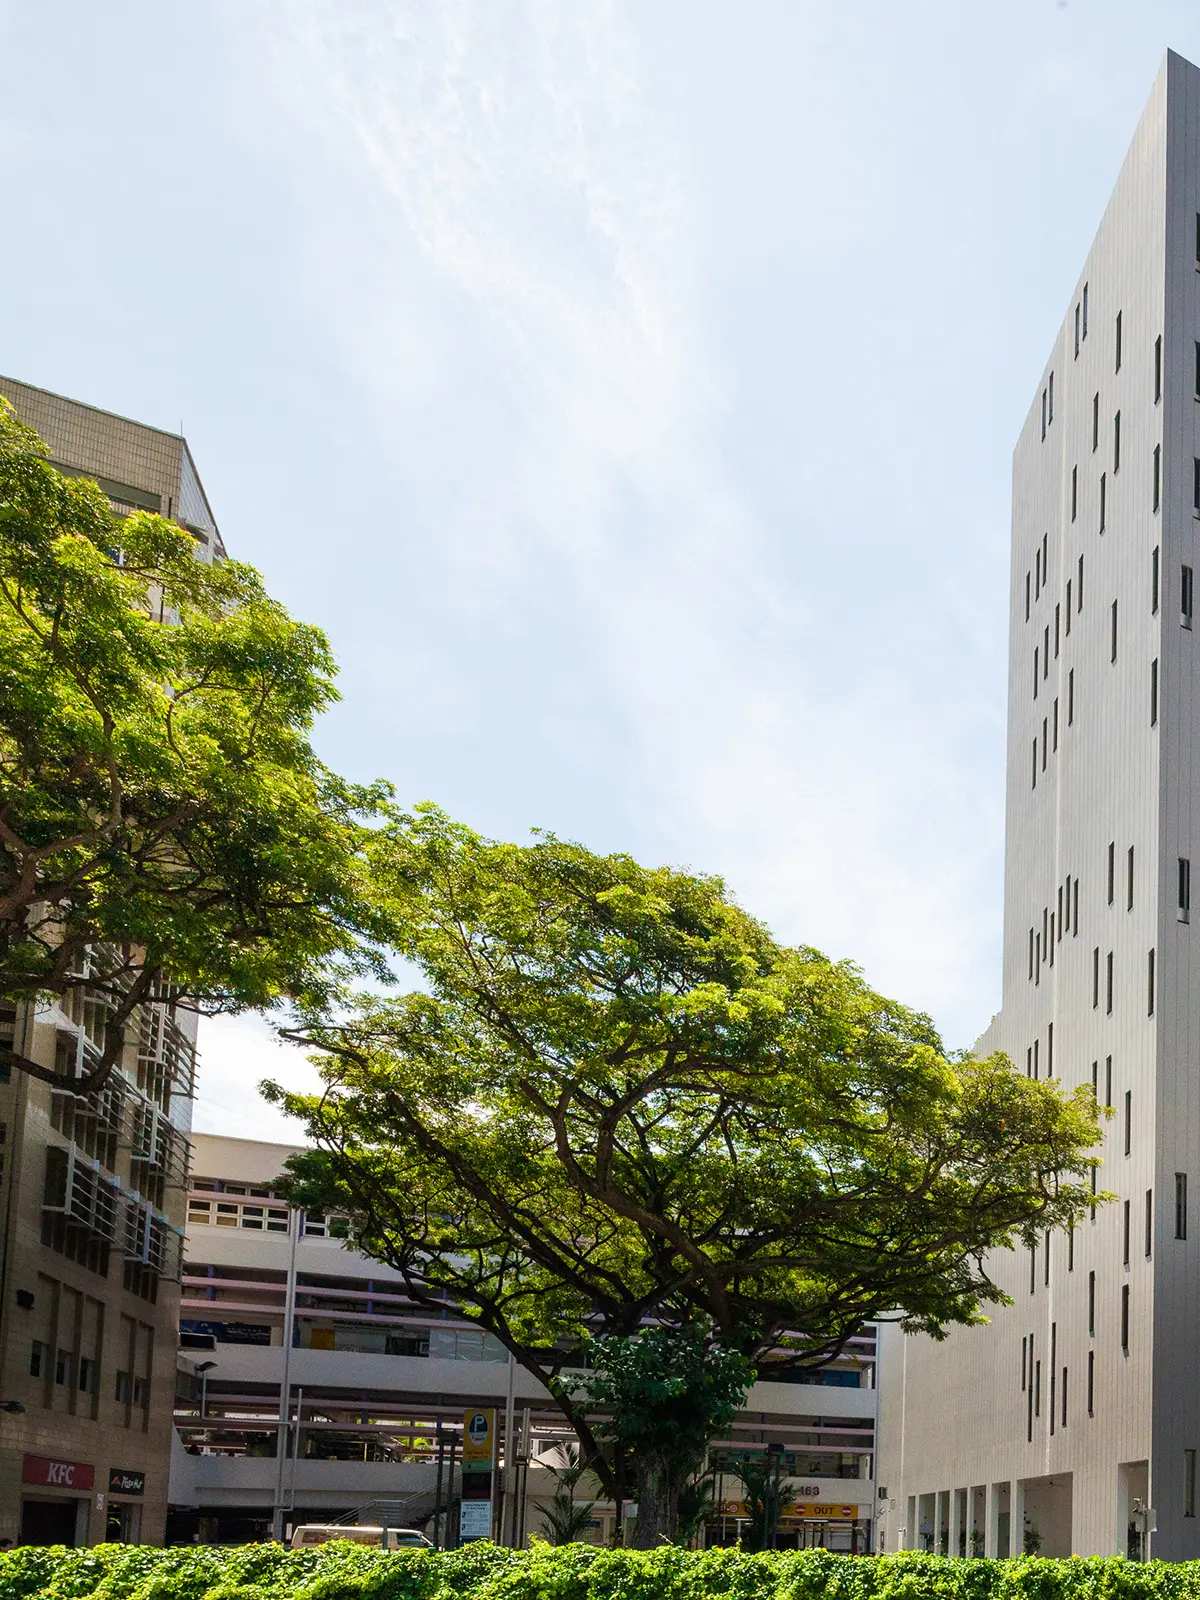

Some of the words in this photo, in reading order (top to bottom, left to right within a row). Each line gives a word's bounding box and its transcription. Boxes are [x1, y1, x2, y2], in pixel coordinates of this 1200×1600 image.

[47, 1462, 75, 1485] KFC
[801, 1486, 820, 1496] 163
[813, 1506, 834, 1515] OUT
